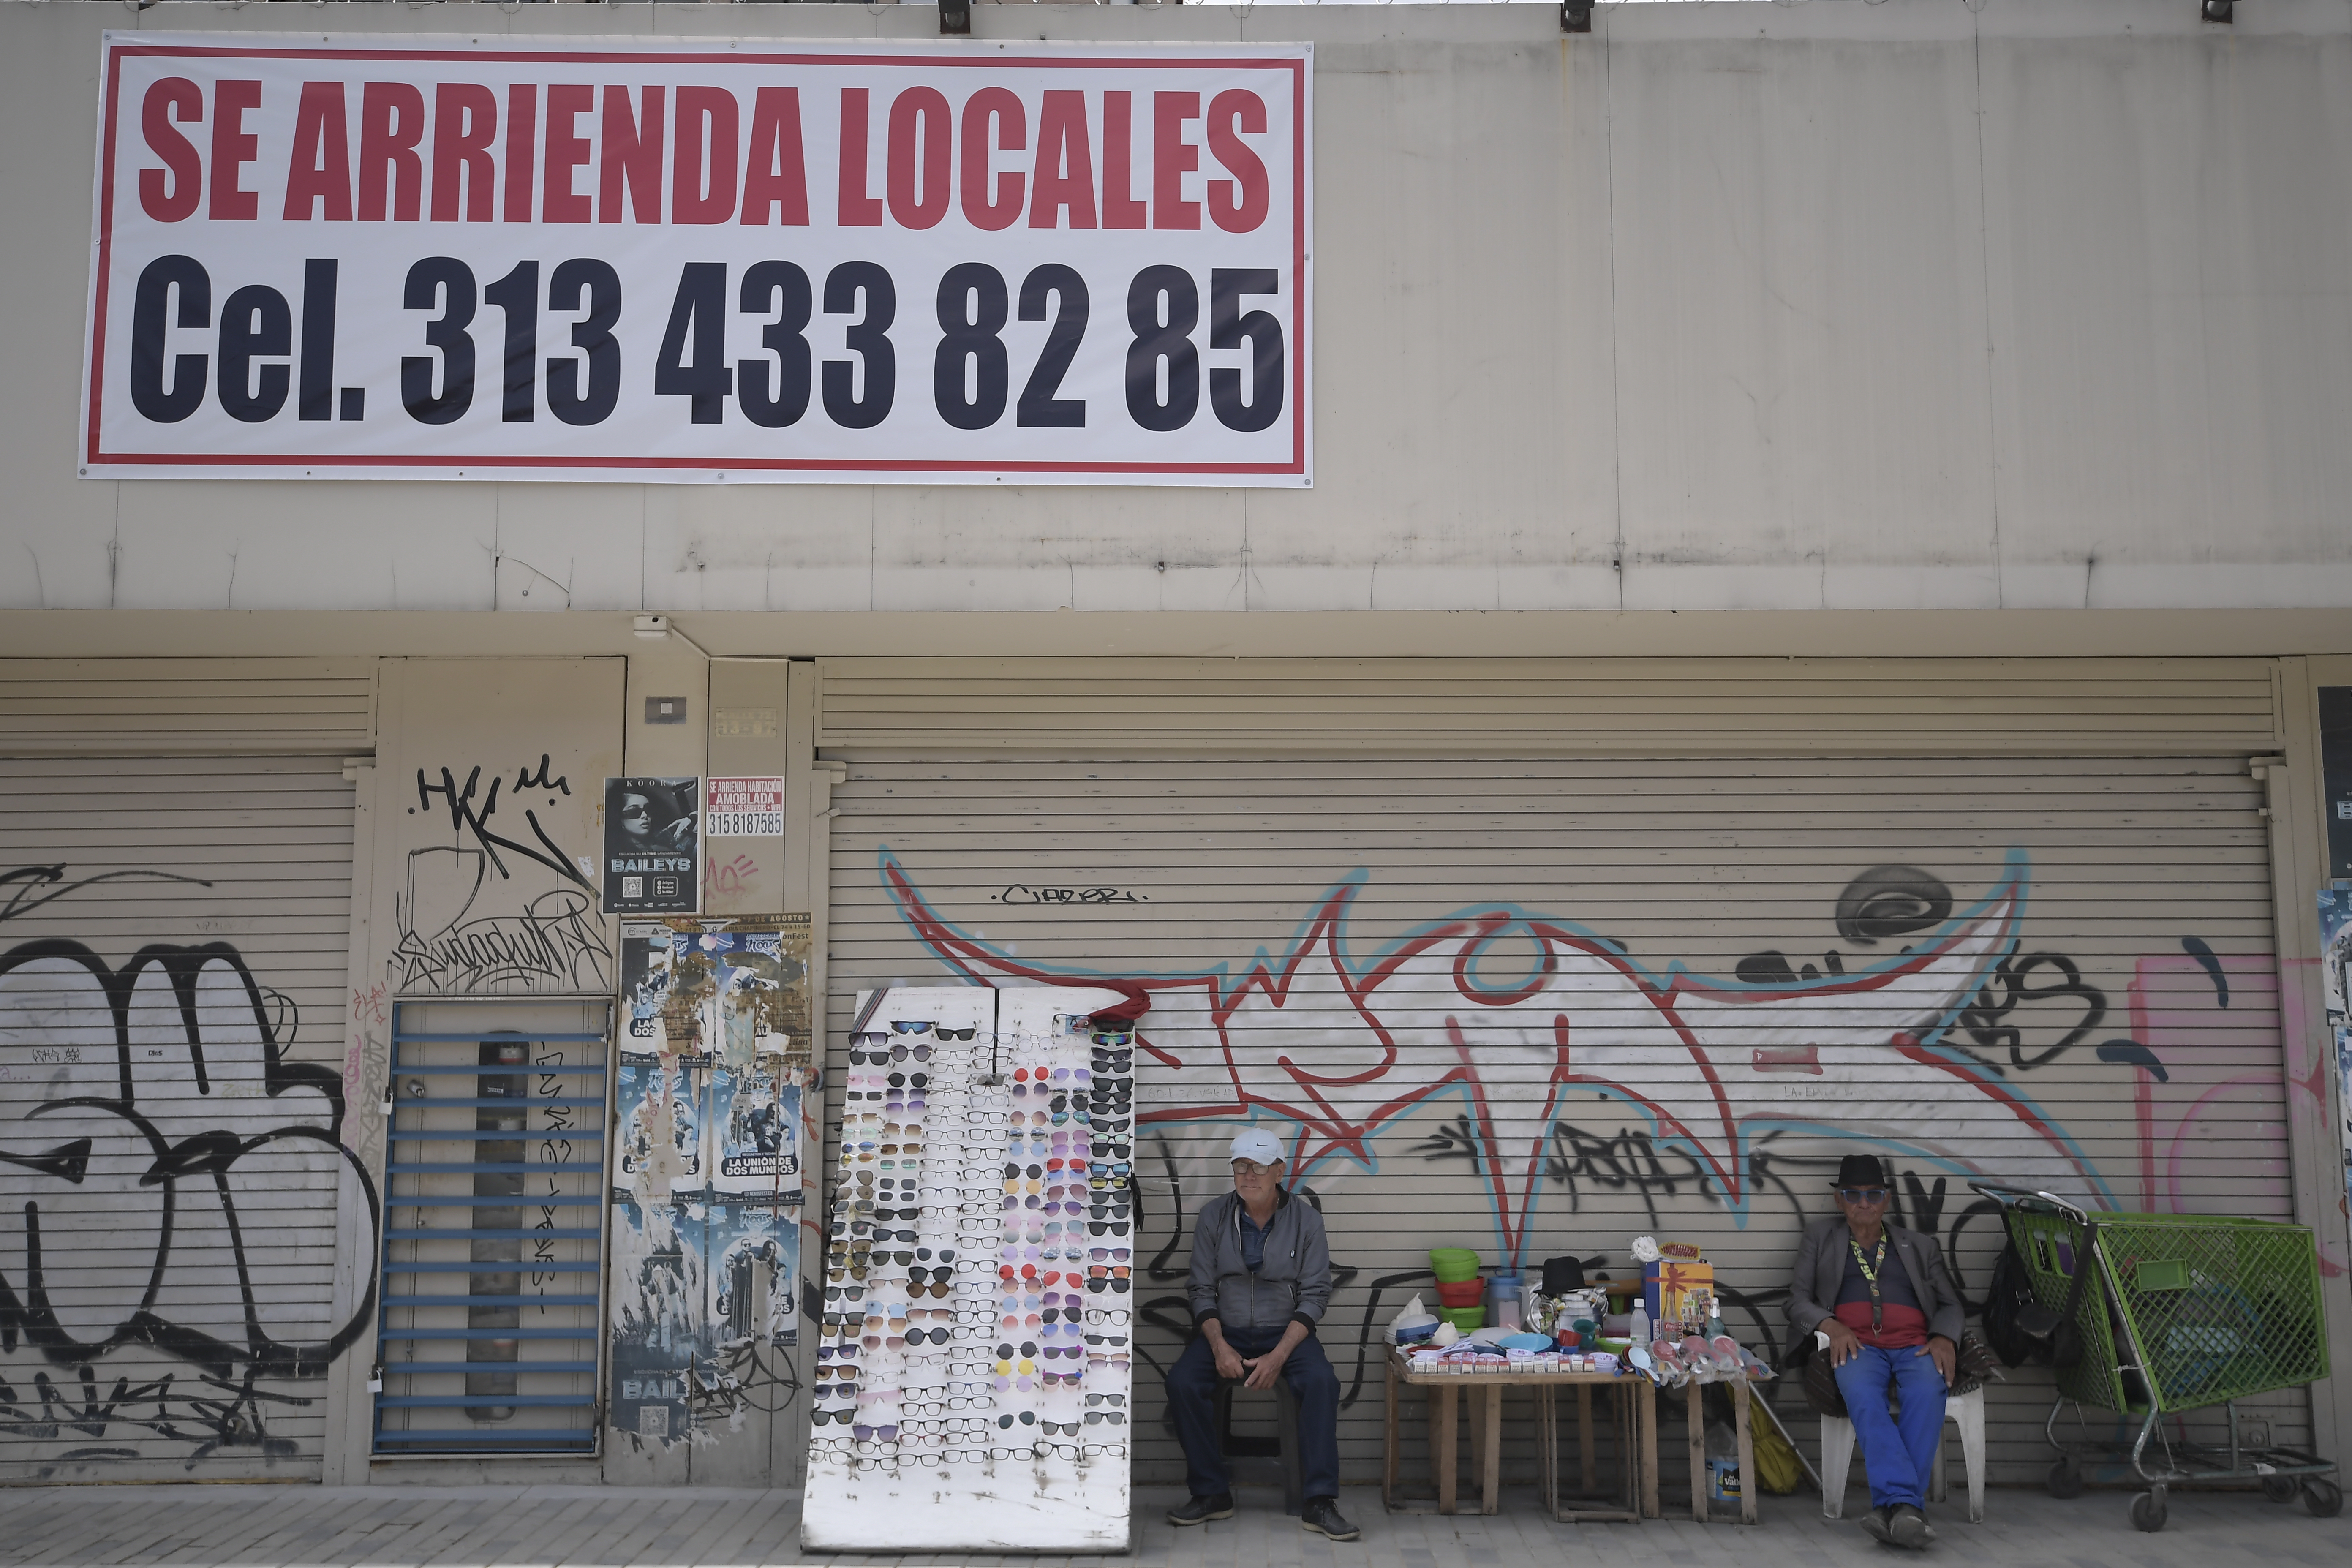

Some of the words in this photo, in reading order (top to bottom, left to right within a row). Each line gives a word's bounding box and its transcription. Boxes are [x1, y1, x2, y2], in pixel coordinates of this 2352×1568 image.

[139, 79, 260, 221] SE
[283, 83, 808, 225] ARRIENDA
[838, 86, 1269, 233] LOCALES
[130, 254, 365, 423] Cel.
[400, 257, 622, 425] 313
[654, 260, 896, 428] 433
[934, 262, 1089, 430] 82
[1125, 264, 1284, 432] 85
[710, 781, 716, 793] SE
[718, 781, 746, 792] ARRIENDA
[748, 779, 781, 792] HABITACIÓN
[716, 792, 774, 804] AMOBLADA
[710, 814, 730, 834] 315
[733, 813, 781, 833] 8187585
[611, 858, 691, 872] BAILEYS
[634, 1027, 656, 1035] DOS
[729, 1159, 742, 1167] LA
[743, 1157, 776, 1167] UNIÓN
[778, 1157, 792, 1165] DE
[726, 1167, 748, 1175] DOS
[749, 1165, 795, 1174] MUNDOS
[623, 1379, 687, 1399] BAIL
